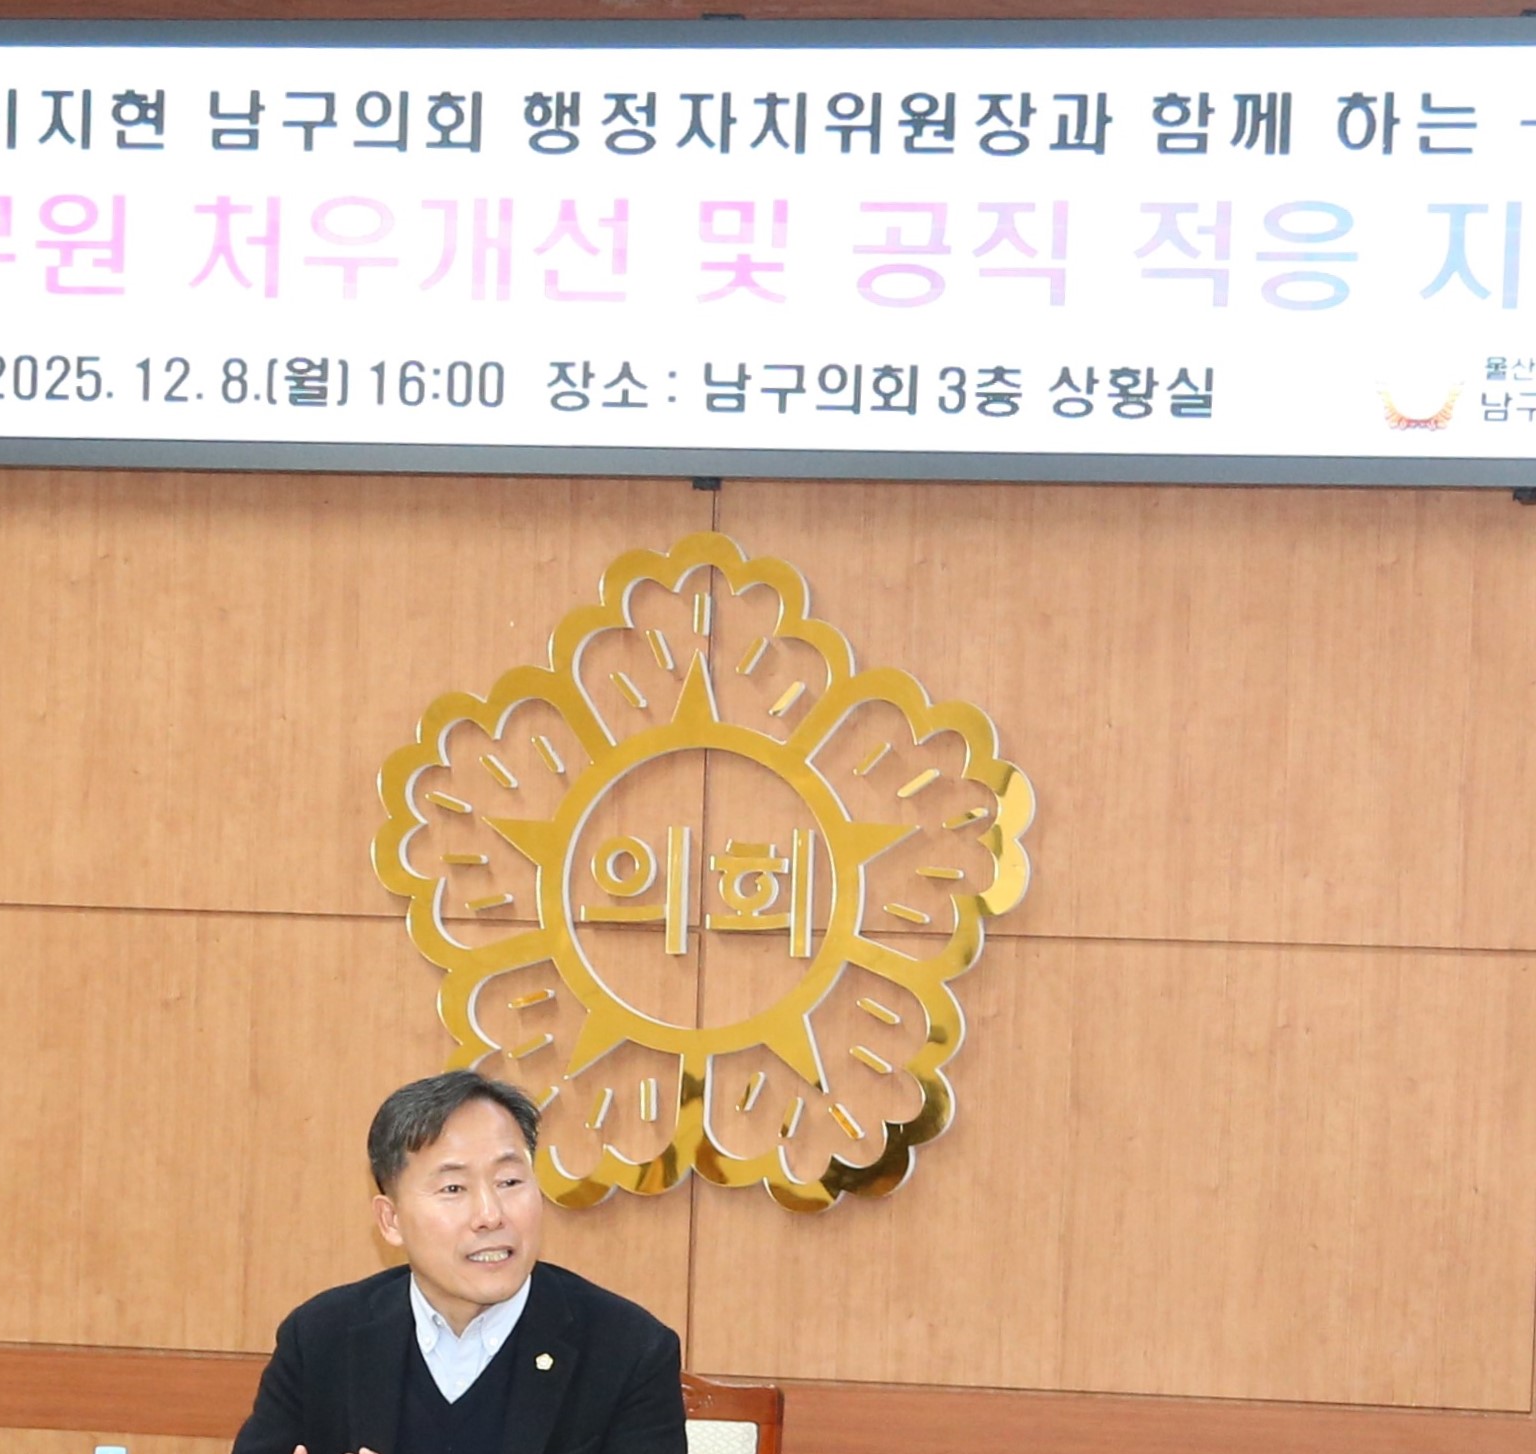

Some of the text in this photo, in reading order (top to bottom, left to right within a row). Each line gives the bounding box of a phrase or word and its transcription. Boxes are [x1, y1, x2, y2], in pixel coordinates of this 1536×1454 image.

[210, 90, 483, 153] 남구의회
[524, 92, 1114, 157] 행정자치위원장과
[1153, 92, 1293, 156] 함께
[1338, 92, 1478, 156] 하는
[189, 196, 629, 302] 처우개선
[695, 199, 789, 303] 및
[851, 201, 1069, 308] 공직
[1134, 201, 1359, 311] 적응
[371, 360, 505, 408] 16:00
[703, 363, 919, 416] 남구의회
[938, 366, 1023, 418] 3층
[1049, 366, 1214, 420] 상황실
[580, 824, 816, 958] 의회
